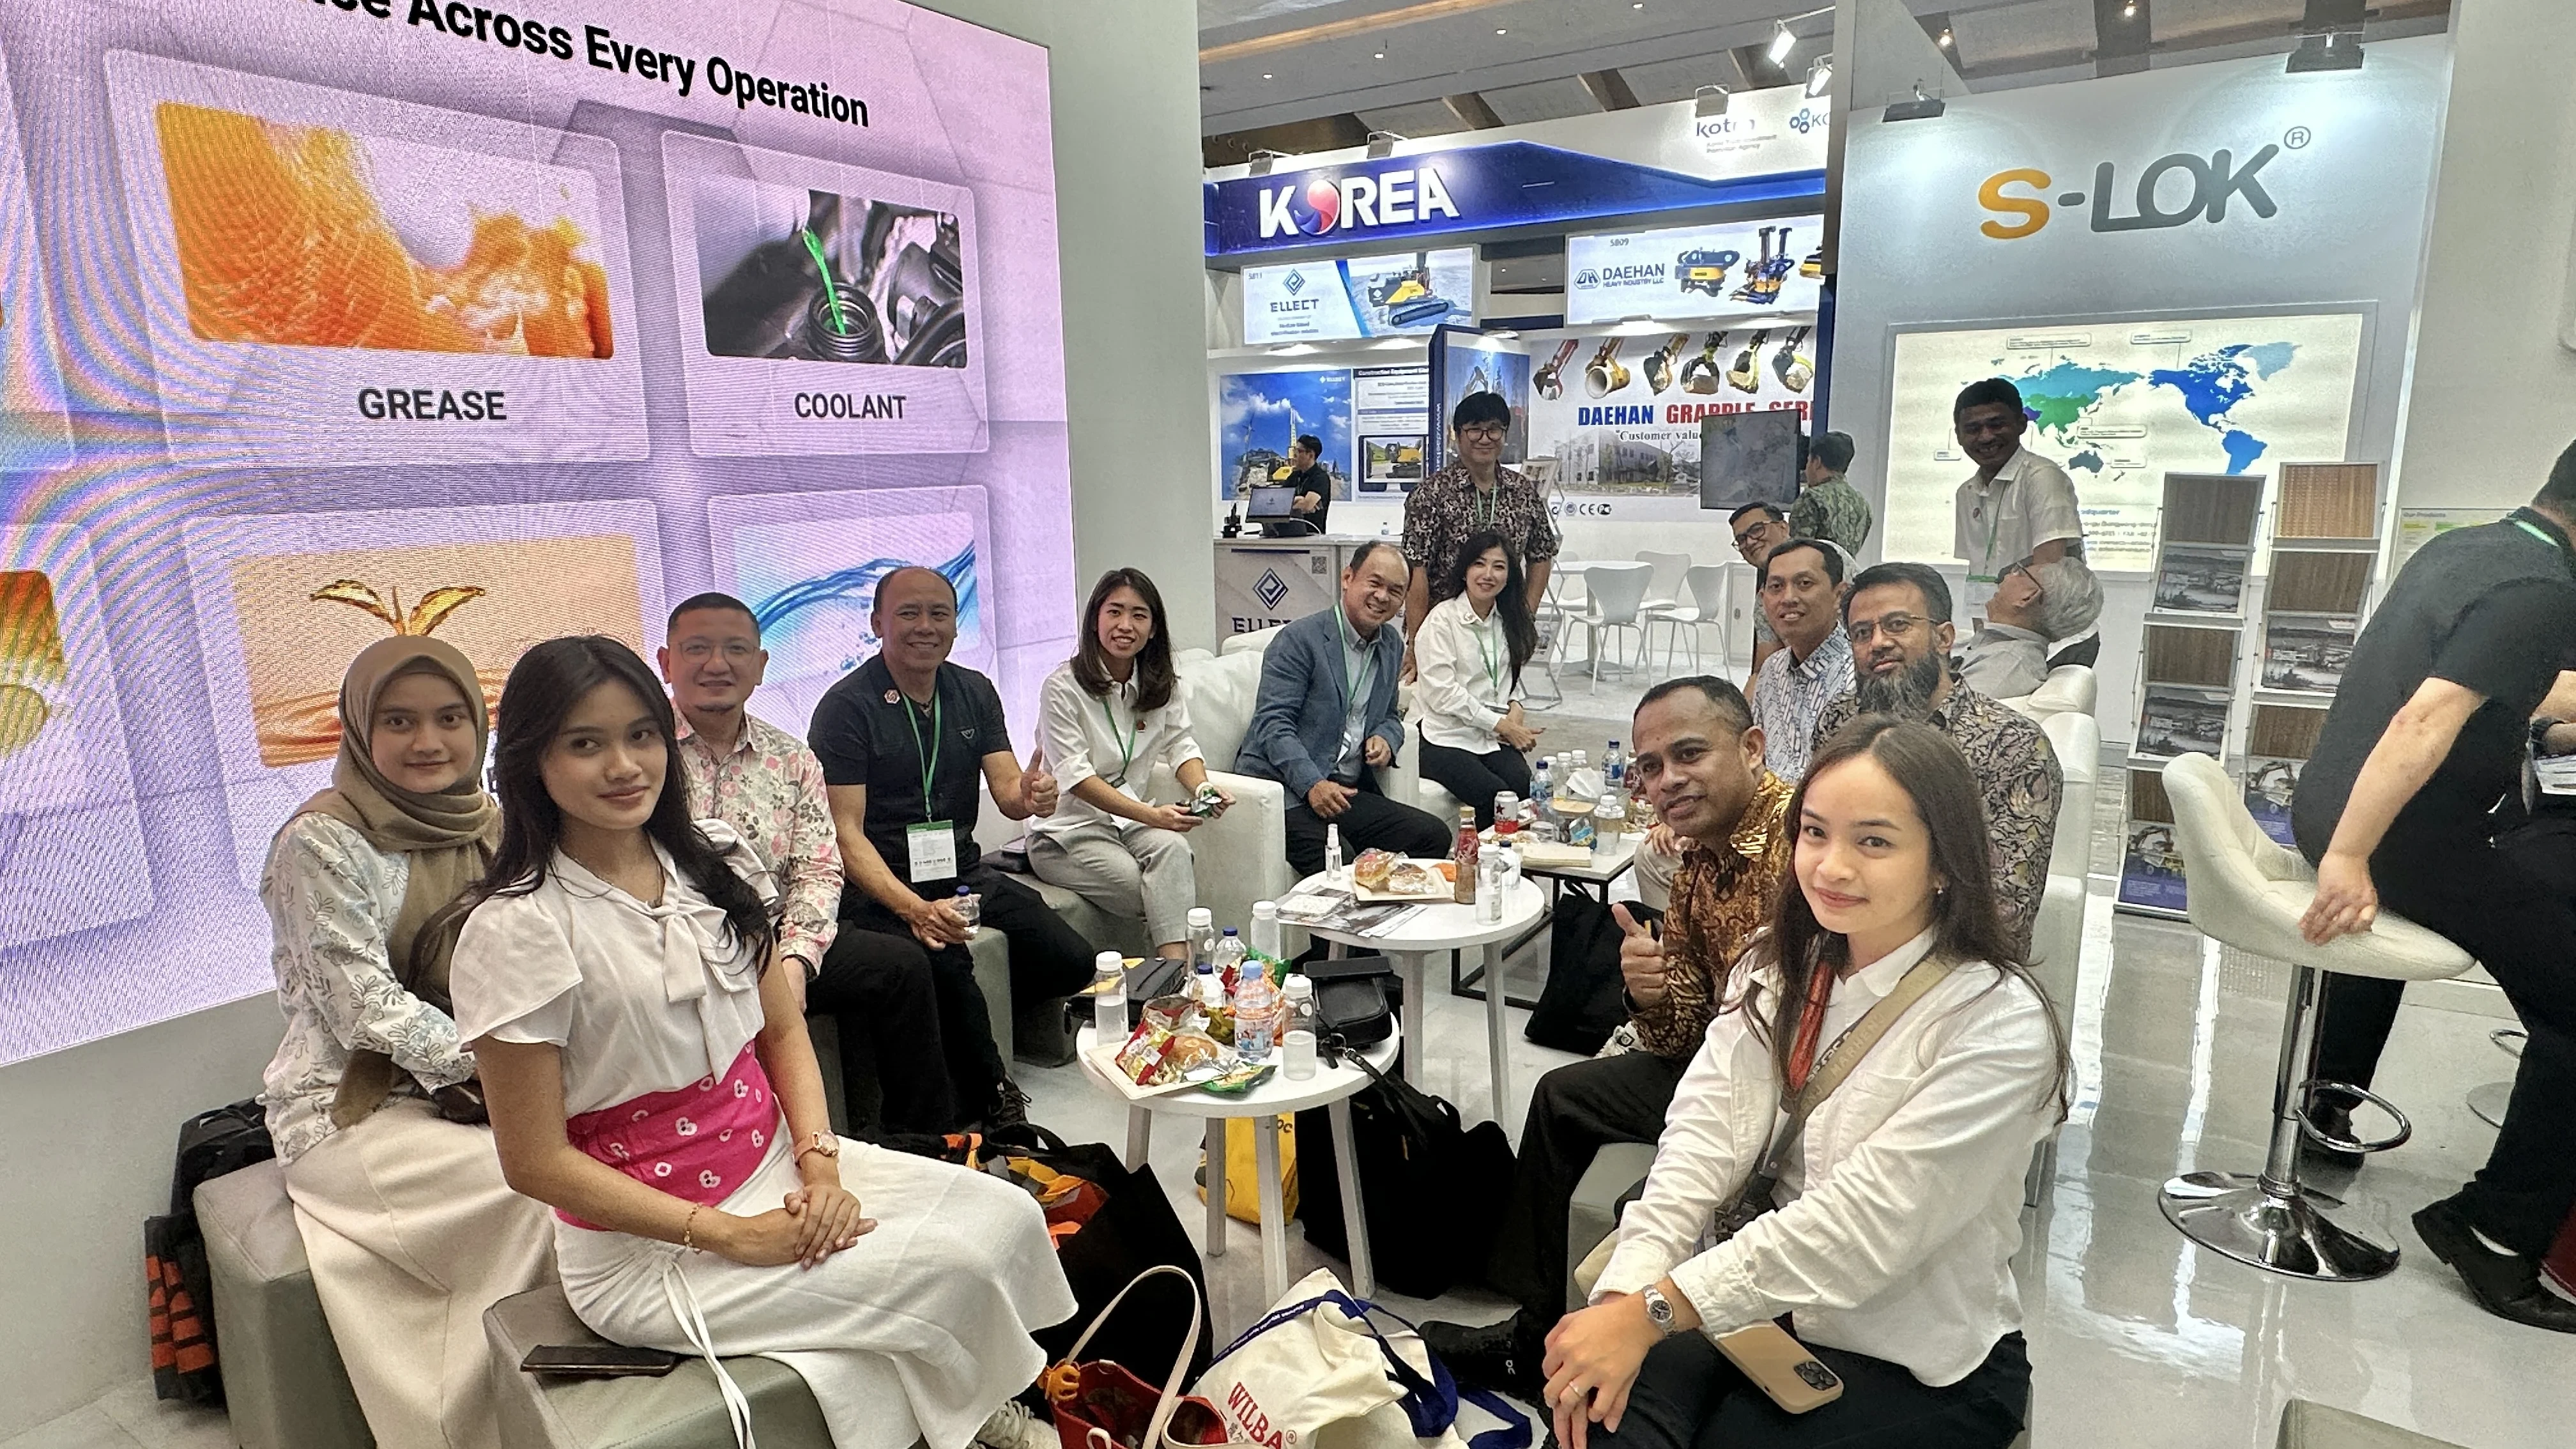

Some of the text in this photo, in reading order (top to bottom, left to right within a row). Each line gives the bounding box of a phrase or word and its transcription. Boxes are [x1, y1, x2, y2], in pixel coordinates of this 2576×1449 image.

[408, 0, 869, 127] Across Every Operation
[1259, 167, 1460, 238] KOREA
[1977, 143, 2280, 240] S-LOK
[1602, 263, 1665, 280] DAEHAN
[1269, 298, 1320, 313] ELLECT
[358, 388, 508, 422] GREASE
[794, 392, 907, 420] COOLANT
[1578, 405, 1654, 426] DAEHAN
[1232, 617, 1292, 633] ELLE
[1228, 1381, 1283, 1449] WILBA
